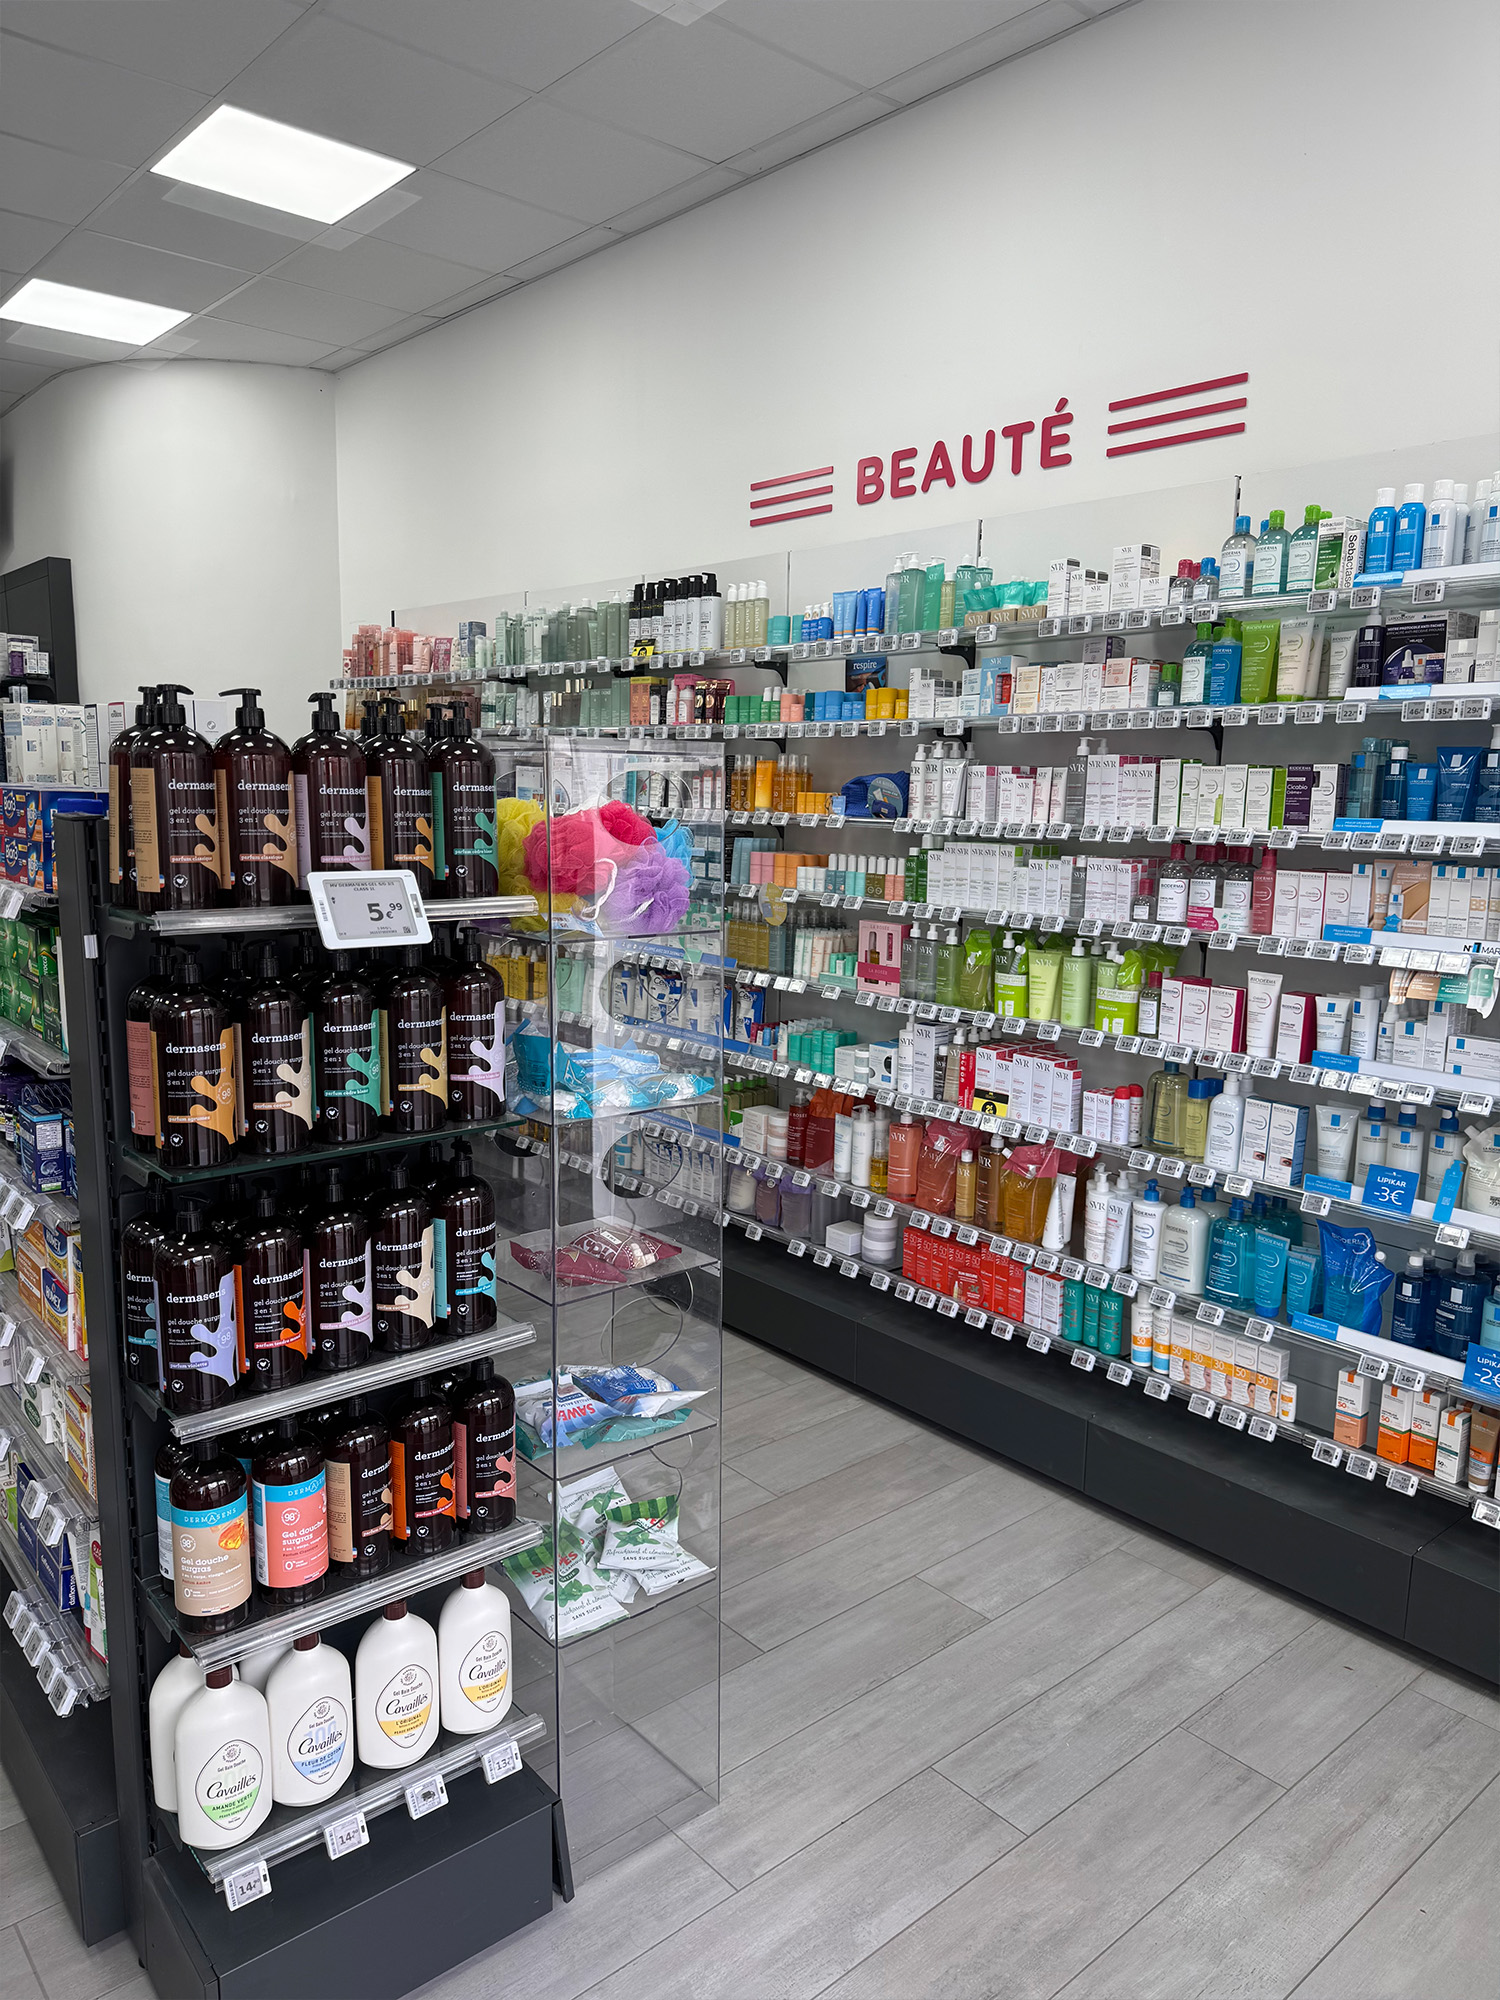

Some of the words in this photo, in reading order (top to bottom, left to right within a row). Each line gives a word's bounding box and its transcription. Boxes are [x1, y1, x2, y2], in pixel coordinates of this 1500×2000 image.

[856, 397, 1075, 505] BEAUTÉ
[1050, 563, 1064, 571] SVR
[956, 571, 971, 580] SVR
[967, 614, 984, 624] SVR
[993, 611, 1010, 622] SVR
[1020, 608, 1039, 619] SVR
[852, 659, 878, 672] respire
[1069, 762, 1085, 773] SVR
[1103, 759, 1116, 768] SVR
[1138, 769, 1154, 778] SVR
[1286, 783, 1308, 791] Cicobio
[929, 853, 942, 862] SVR
[1030, 862, 1043, 872] SVR
[1088, 863, 1102, 872] SVR
[1117, 867, 1130, 875] SVR
[1073, 871, 1086, 879] SVR
[1469, 898, 1487, 911] BB
[1035, 958, 1053, 968] SVR
[1063, 962, 1079, 972] SVR
[1099, 966, 1114, 977] SVR
[1250, 977, 1276, 985] BIODERMA
[1212, 989, 1235, 997] BIODERMA
[323, 1021, 376, 1033] dermasens
[251, 1032, 306, 1043] dermasens
[916, 1028, 931, 1039] SVR
[899, 1037, 914, 1046] SVR
[165, 1042, 227, 1054] dermasens
[978, 1051, 992, 1061] SVR
[997, 1062, 1010, 1072] SVR
[1015, 1057, 1030, 1068] SVR
[1035, 1061, 1051, 1072] SVR
[166, 1070, 180, 1078] gel
[181, 1068, 204, 1077] douche
[1055, 1071, 1069, 1081] SVR
[1246, 1101, 1270, 1110] BIODERMA
[1273, 1106, 1297, 1114] BIODERMA
[1213, 1110, 1235, 1119] BIODERMA
[891, 1132, 906, 1143] SVR
[979, 1156, 992, 1168] SVR
[1377, 1176, 1407, 1188] LIPIKAR
[1373, 1186, 1405, 1206] -3€
[1089, 1200, 1106, 1211] SVR
[1108, 1204, 1124, 1216] SVR
[1166, 1224, 1188, 1234] BIODERMA
[1213, 1237, 1237, 1247] BIODERMA
[1257, 1235, 1284, 1248] BIODERMA
[1331, 1232, 1366, 1247] BIODERMA
[1289, 1257, 1311, 1268] BIODERMA
[253, 1266, 304, 1285] dermasens
[1028, 1274, 1039, 1283] SVR
[1045, 1280, 1057, 1290] SVR
[166, 1288, 226, 1304] dermasens
[1101, 1300, 1119, 1311] SVR
[184, 1507, 237, 1524] DERMASENS
[281, 1530, 297, 1539] Gel
[299, 1519, 324, 1536] douche
[282, 1533, 313, 1546] surgras
[181, 1556, 194, 1566] Gel
[195, 1554, 229, 1566] douche
[181, 1564, 212, 1575] surgras
[664, 1571, 678, 1580] SANS
[677, 1566, 692, 1575] SUCRE
[572, 1611, 586, 1621] SANS
[586, 1605, 603, 1615] SUCRE
[468, 1658, 506, 1681] Cavaillès
[386, 1692, 428, 1716] Cavaillès
[395, 1713, 422, 1726] L'ORIGINAL
[298, 1729, 343, 1756] Cavaillès
[301, 1758, 318, 1767] FLEUR
[326, 1746, 342, 1759] COTON
[206, 1773, 257, 1800] Cavaillès
[211, 1801, 236, 1812] AMANDE
[236, 1791, 253, 1804] VERTE
